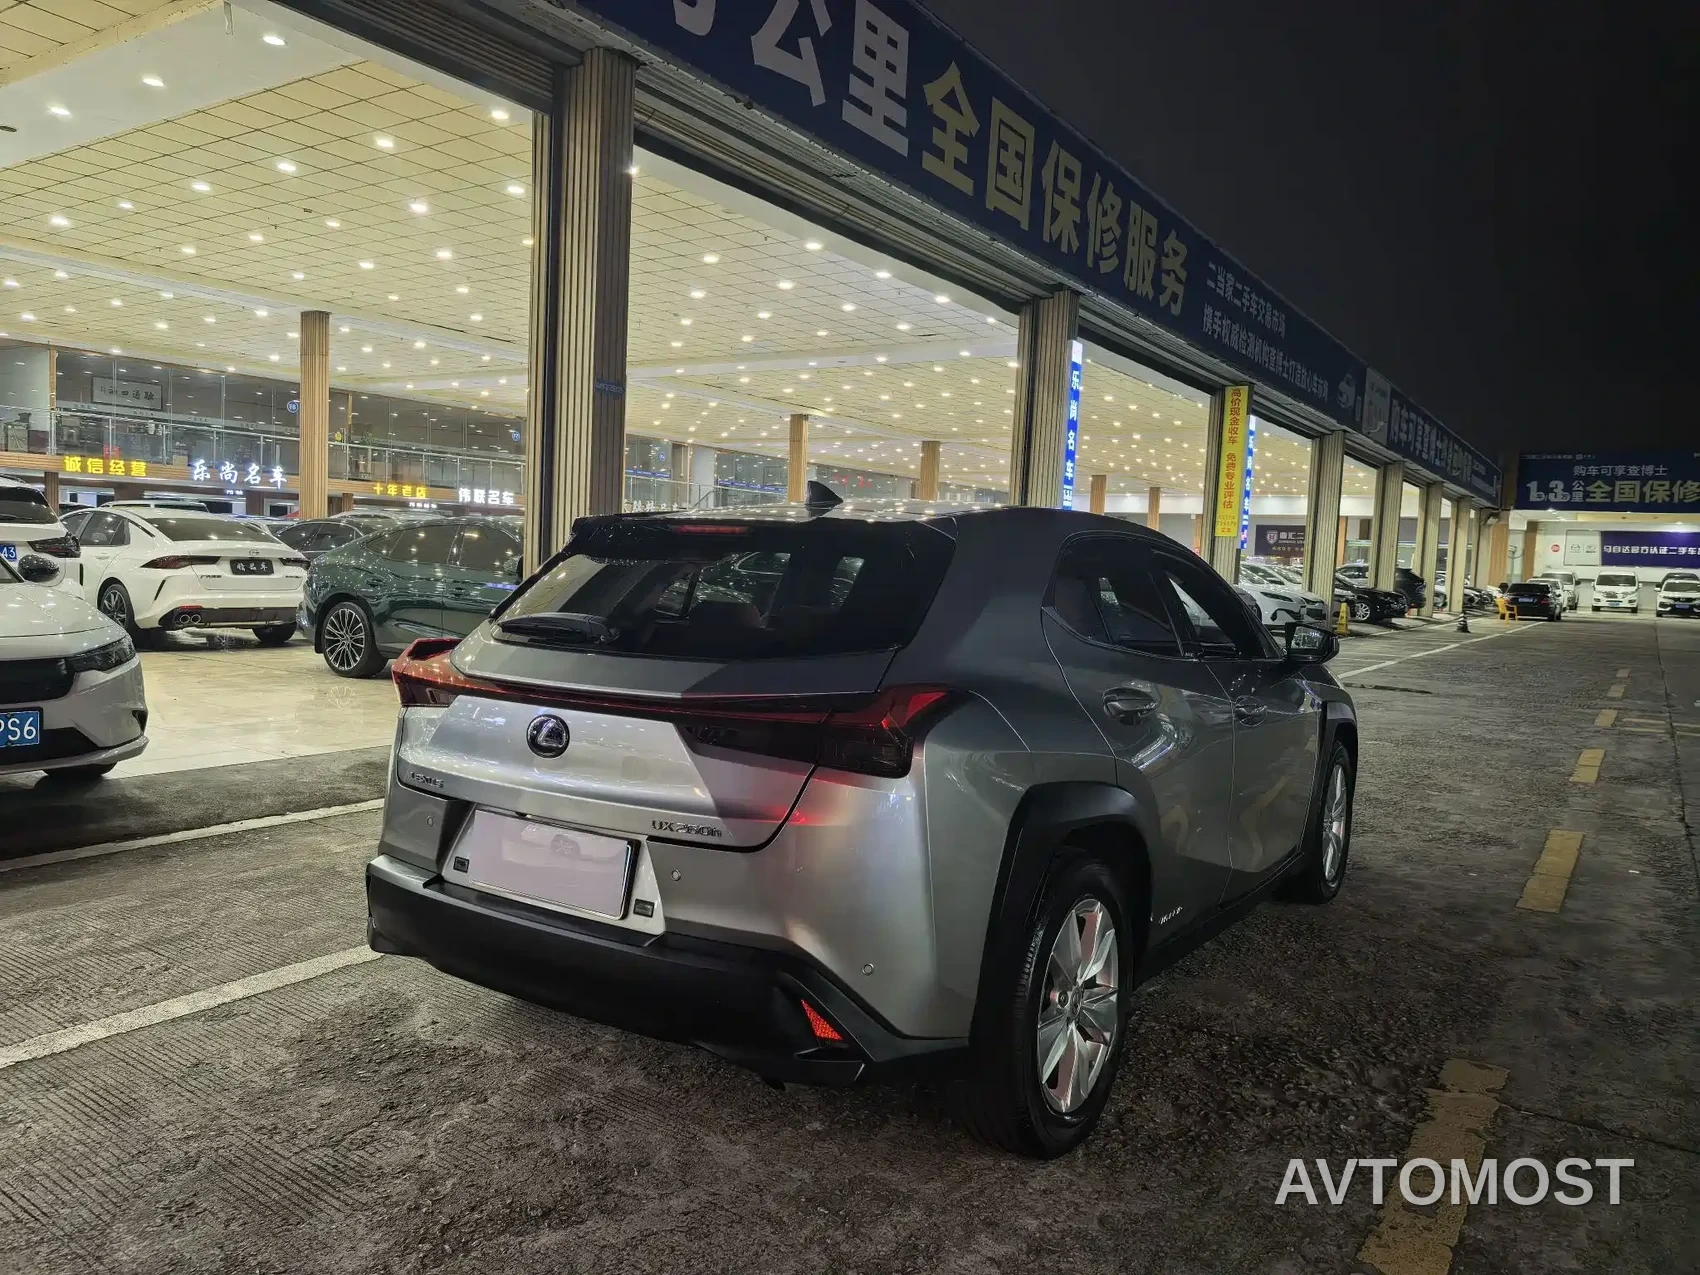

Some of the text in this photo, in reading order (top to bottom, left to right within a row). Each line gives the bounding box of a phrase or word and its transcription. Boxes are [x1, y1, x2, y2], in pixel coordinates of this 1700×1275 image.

[672, 0, 1188, 316] 公里全国保修服务
[1206, 261, 1286, 339] 二当家二手车交易市场
[1065, 371, 1080, 480] 乐尚名车
[1228, 388, 1242, 445] 高价现金收车
[64, 455, 147, 477] 诚信经营
[192, 458, 287, 489] 乐尚名车
[1223, 452, 1236, 508] 免费专业评估
[1573, 465, 1669, 477] 购车可享查博士
[373, 482, 428, 499] 十年老店
[458, 487, 515, 505] 伟联名车
[1604, 546, 1700, 555] 马自达官方认证二手车
